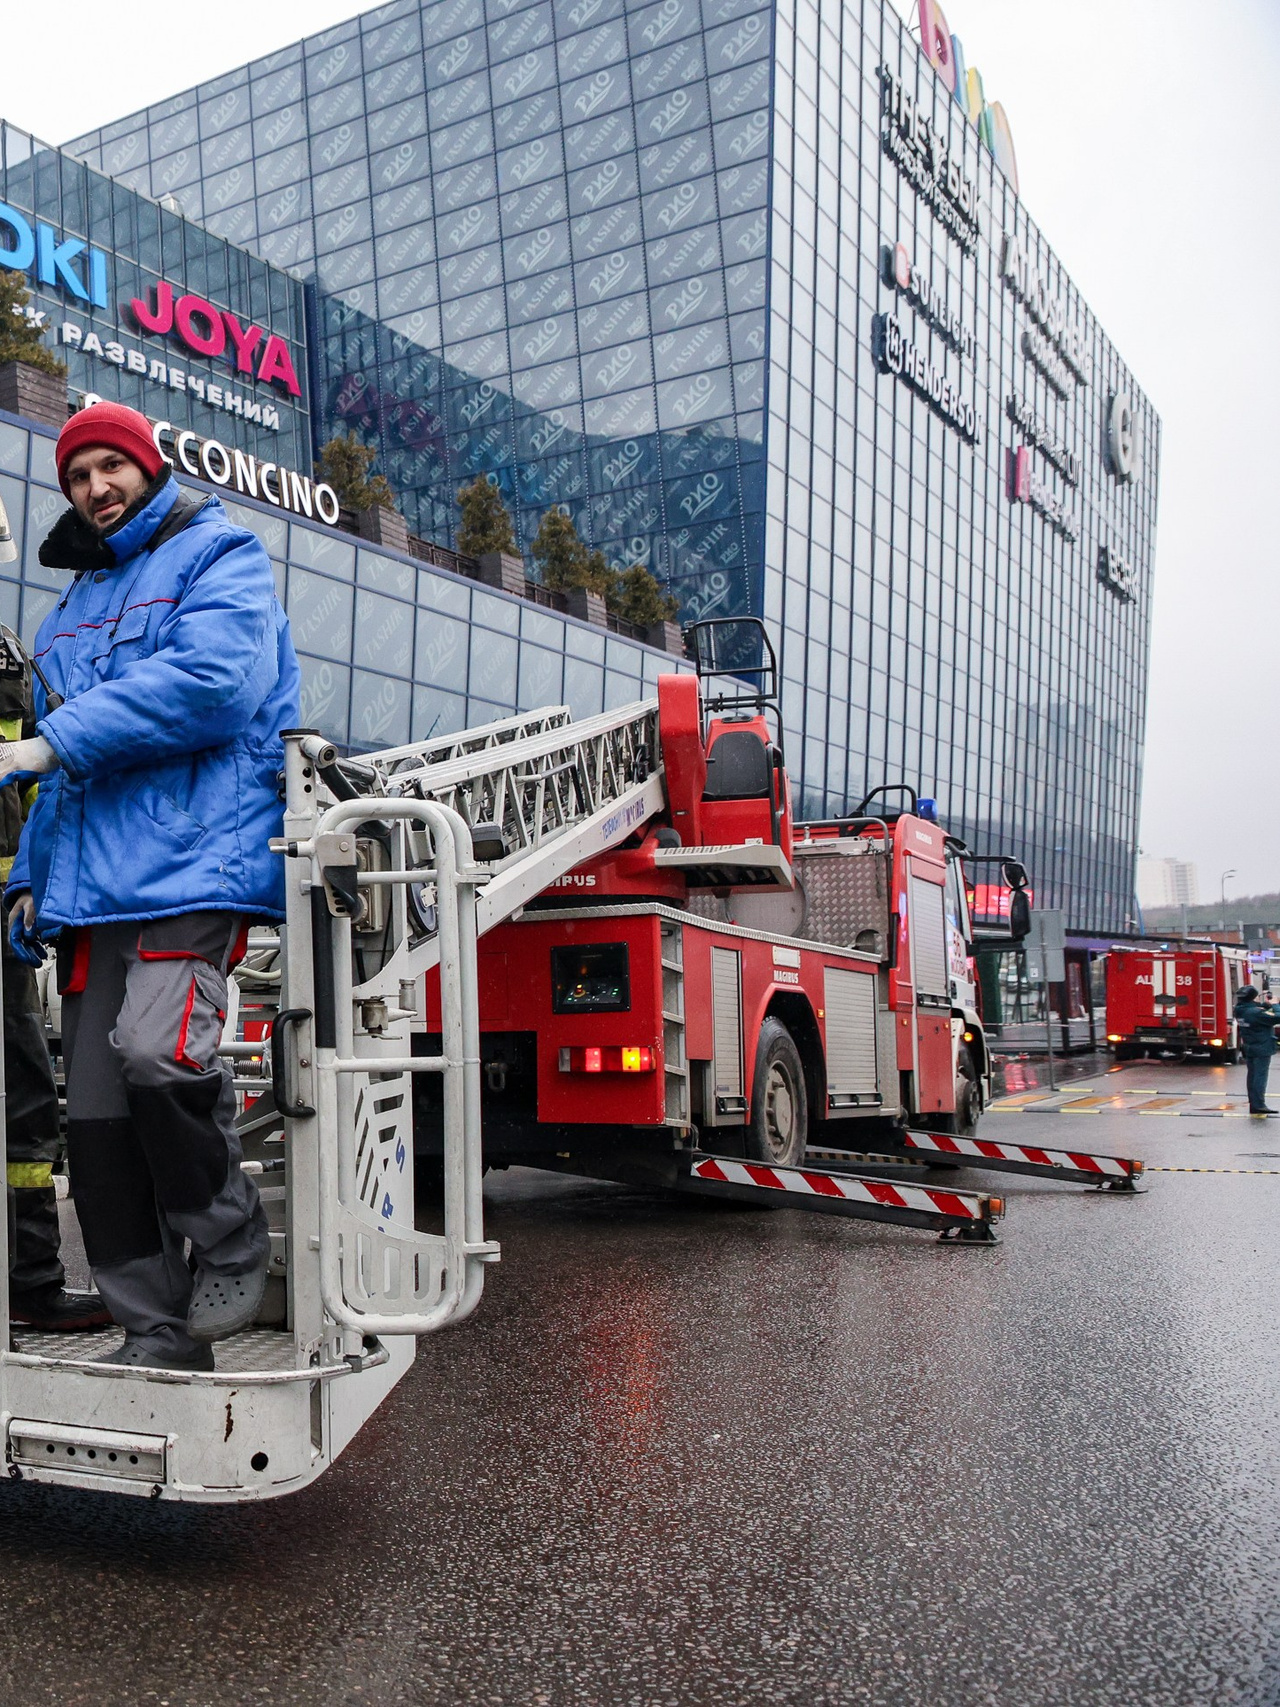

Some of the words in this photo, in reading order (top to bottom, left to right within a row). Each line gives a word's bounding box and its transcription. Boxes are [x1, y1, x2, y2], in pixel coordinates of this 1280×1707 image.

[643, 1, 680, 43] РИО
[722, 15, 760, 62] РИО
[437, 37, 469, 77] РИО
[504, 53, 538, 94] РИО
[575, 70, 610, 114] РИО
[650, 90, 686, 133] РИО
[730, 111, 769, 157] РИО
[383, 143, 413, 184] РИО
[511, 140, 544, 181] РИО
[582, 161, 618, 205] РИО
[449, 205, 481, 247] РИО
[658, 183, 696, 228] РИО
[518, 228, 551, 269] РИО
[589, 252, 625, 297] РИО
[665, 277, 703, 322] РИО
[131, 281, 302, 397] JOYA
[524, 319, 558, 360] РИО
[63, 322, 280, 431] РАЗВЛЕЧЕНИЙ
[596, 345, 632, 390] РИО
[460, 380, 493, 423] РИО
[673, 373, 711, 419] РИО
[905, 339, 982, 445] HENDERSON
[530, 410, 564, 451] РИО
[84, 392, 340, 526] CCONCINO
[603, 440, 639, 483] РИО
[680, 472, 718, 518] РИО
[297, 587, 341, 643] TASHIR
[687, 572, 726, 618] РИО
[773, 970, 799, 984] MAGIRUS
[1176, 976, 1192, 986] 38
